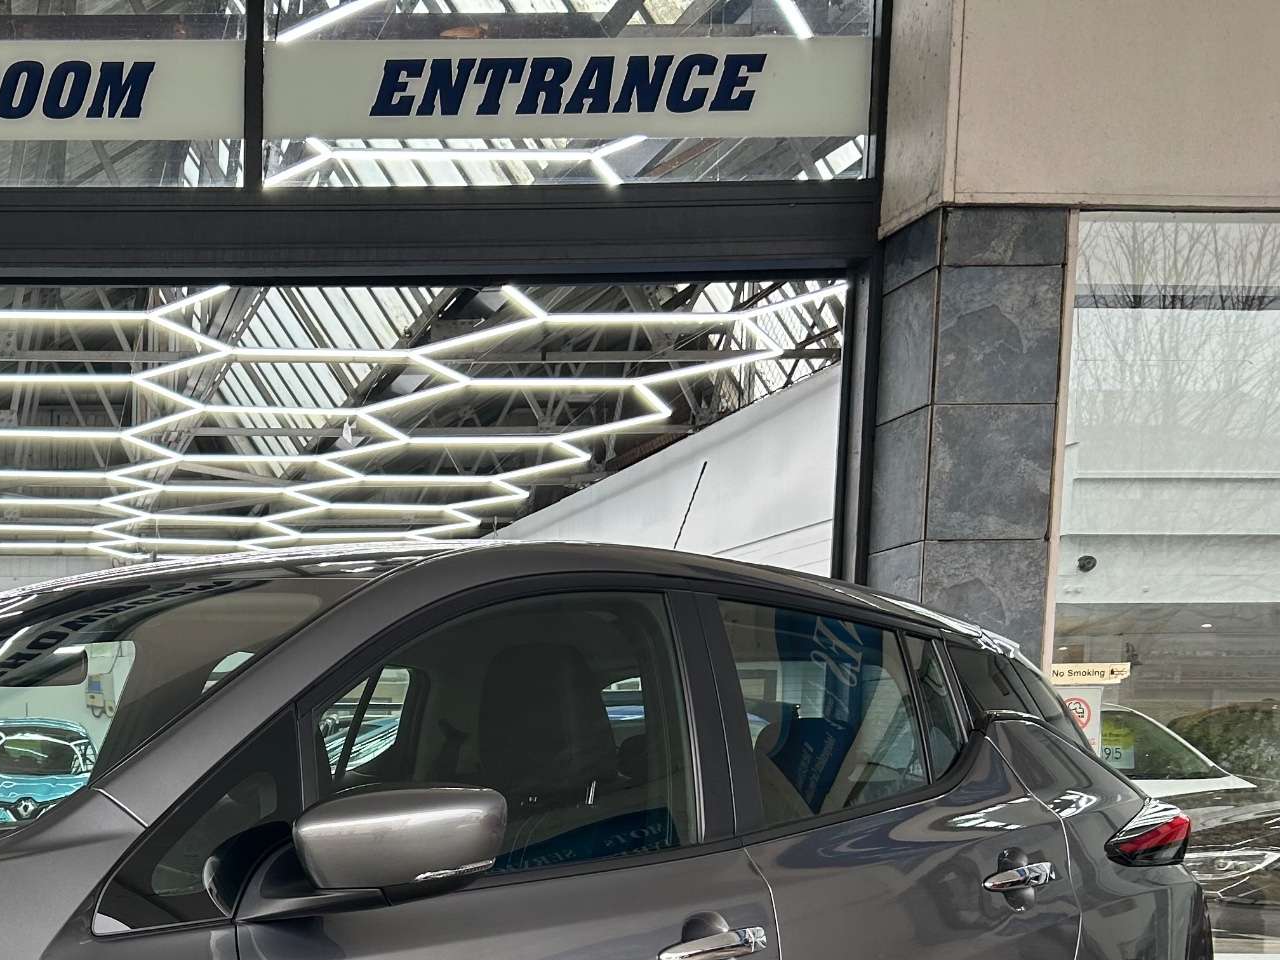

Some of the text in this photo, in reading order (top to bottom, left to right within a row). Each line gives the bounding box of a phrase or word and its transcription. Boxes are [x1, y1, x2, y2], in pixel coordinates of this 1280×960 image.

[369, 53, 768, 117] ENTRANCE
[1052, 668, 1106, 679] No Smoking
